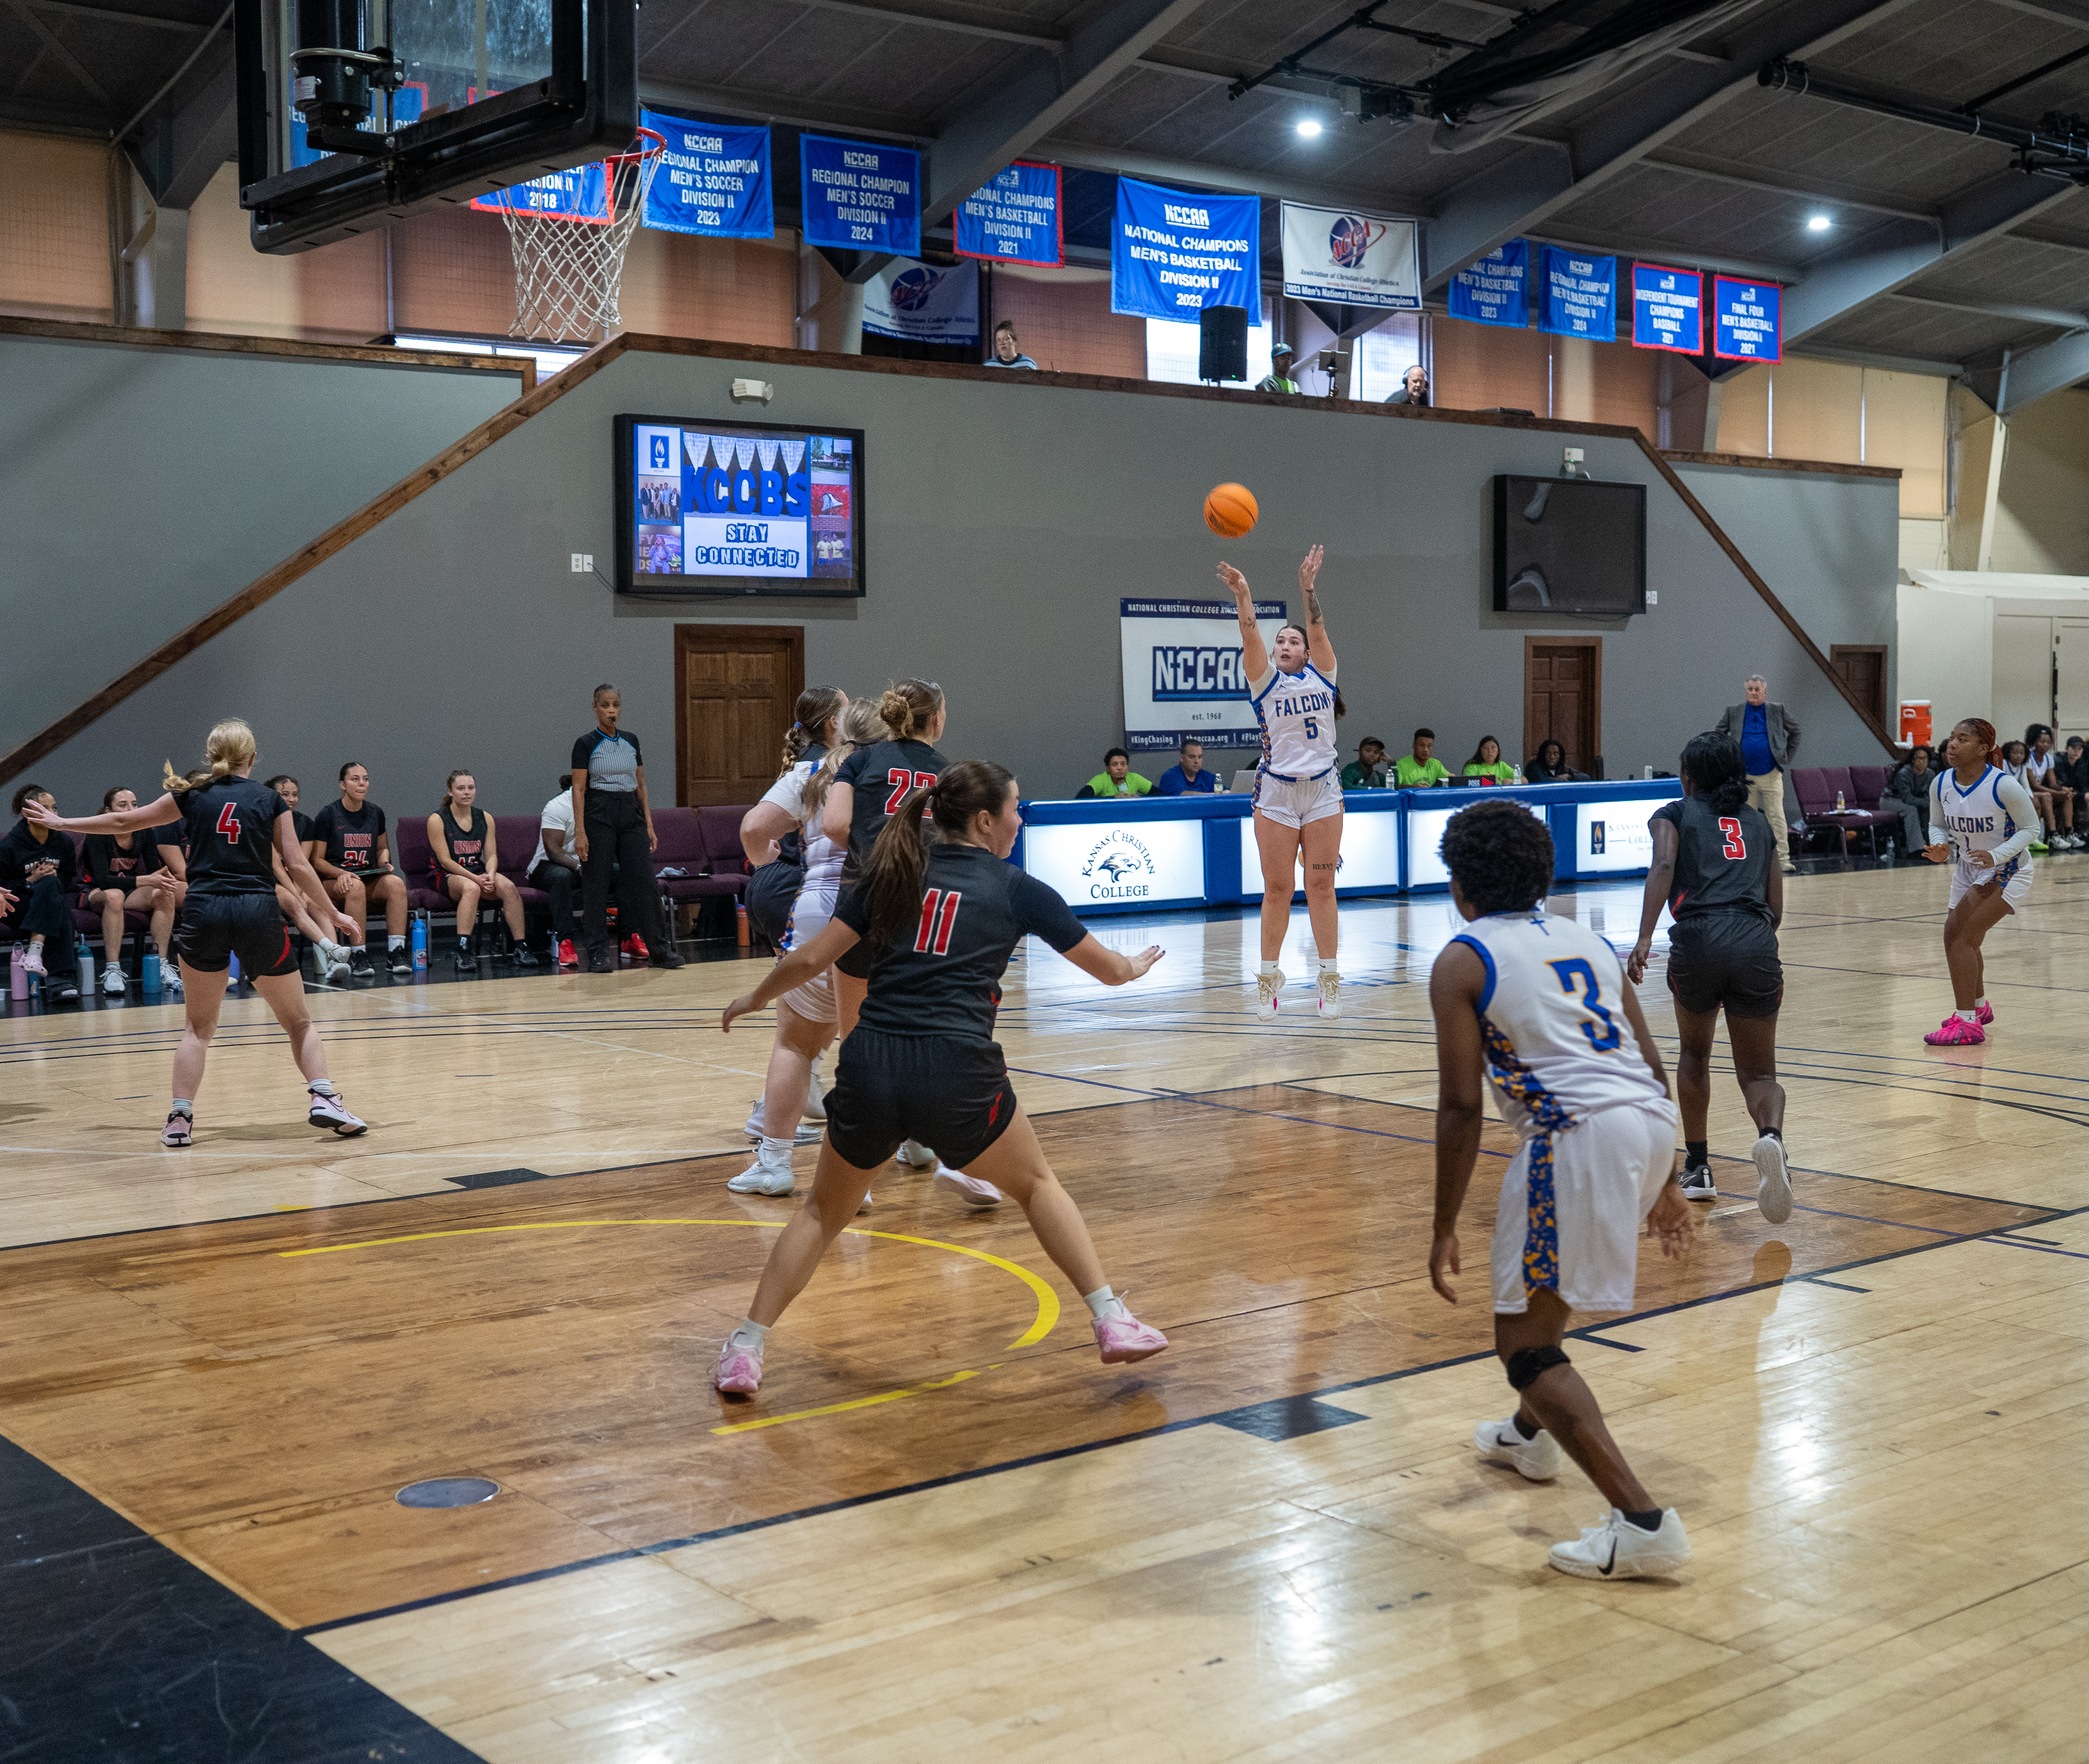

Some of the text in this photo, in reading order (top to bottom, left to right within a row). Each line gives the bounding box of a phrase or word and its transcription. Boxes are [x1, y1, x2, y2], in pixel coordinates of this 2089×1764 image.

[684, 134, 722, 152] NCCAA
[660, 150, 759, 173] EGIONAL CHAMPION
[844, 151, 879, 168] NCCAA
[670, 169, 744, 191] MEN'S SOCCER
[812, 169, 909, 194] REGIONAL CHAMPION
[682, 189, 734, 208] DIVISION II
[827, 188, 895, 210] MEN'S SOCCER
[971, 187, 1055, 210] GIONAL CHAMPIONS
[697, 210, 720, 226] 2023
[838, 207, 887, 225] DIVISION II
[966, 201, 1048, 226] MEN'S BASKETBALL
[1164, 204, 1210, 226] NCCAA
[851, 226, 873, 241] 2024
[985, 221, 1031, 239] DIVISION II
[1124, 224, 1249, 252] NATIONAL CHAMPIONS
[998, 240, 1018, 255] 2021
[1131, 246, 1243, 271] MEN'S BASKETBALL
[1160, 270, 1219, 289] DIVISION II
[1487, 264, 1524, 278] CHAMPIONS
[1458, 272, 1519, 291] MEN'S BASKETBALL
[1176, 293, 1202, 307] 2023
[1286, 284, 1415, 306] 2023 Men's National Basketball Champions
[1471, 290, 1501, 304] DIVISION
[1481, 306, 1497, 318] 2023
[1650, 304, 1684, 320] CHAMPIONS
[1732, 303, 1764, 317] FINAL FOUR
[1740, 316, 1774, 332] BASKETBALL
[684, 465, 807, 517] KCCBS
[726, 524, 768, 543] STAY
[695, 546, 799, 568] CONNECTED
[1128, 604, 1157, 612] NATIONAL
[1159, 604, 1190, 613] CHRISTIAN
[1191, 606, 1219, 614] COLLEGE
[1254, 606, 1280, 614] SOCIATION
[1304, 717, 1318, 739] 5
[1131, 734, 1173, 745] #KingChasing
[216, 802, 241, 844] 4
[1947, 815, 1994, 833] LCONS
[344, 833, 372, 847] UNION
[454, 840, 482, 854] UNION
[1718, 817, 1746, 860] 3
[1082, 830, 1155, 877] KANSAS CHRISTIAN
[1090, 884, 1149, 899] COLLEGE
[913, 888, 962, 956] 11
[1544, 955, 1623, 1055] 3
